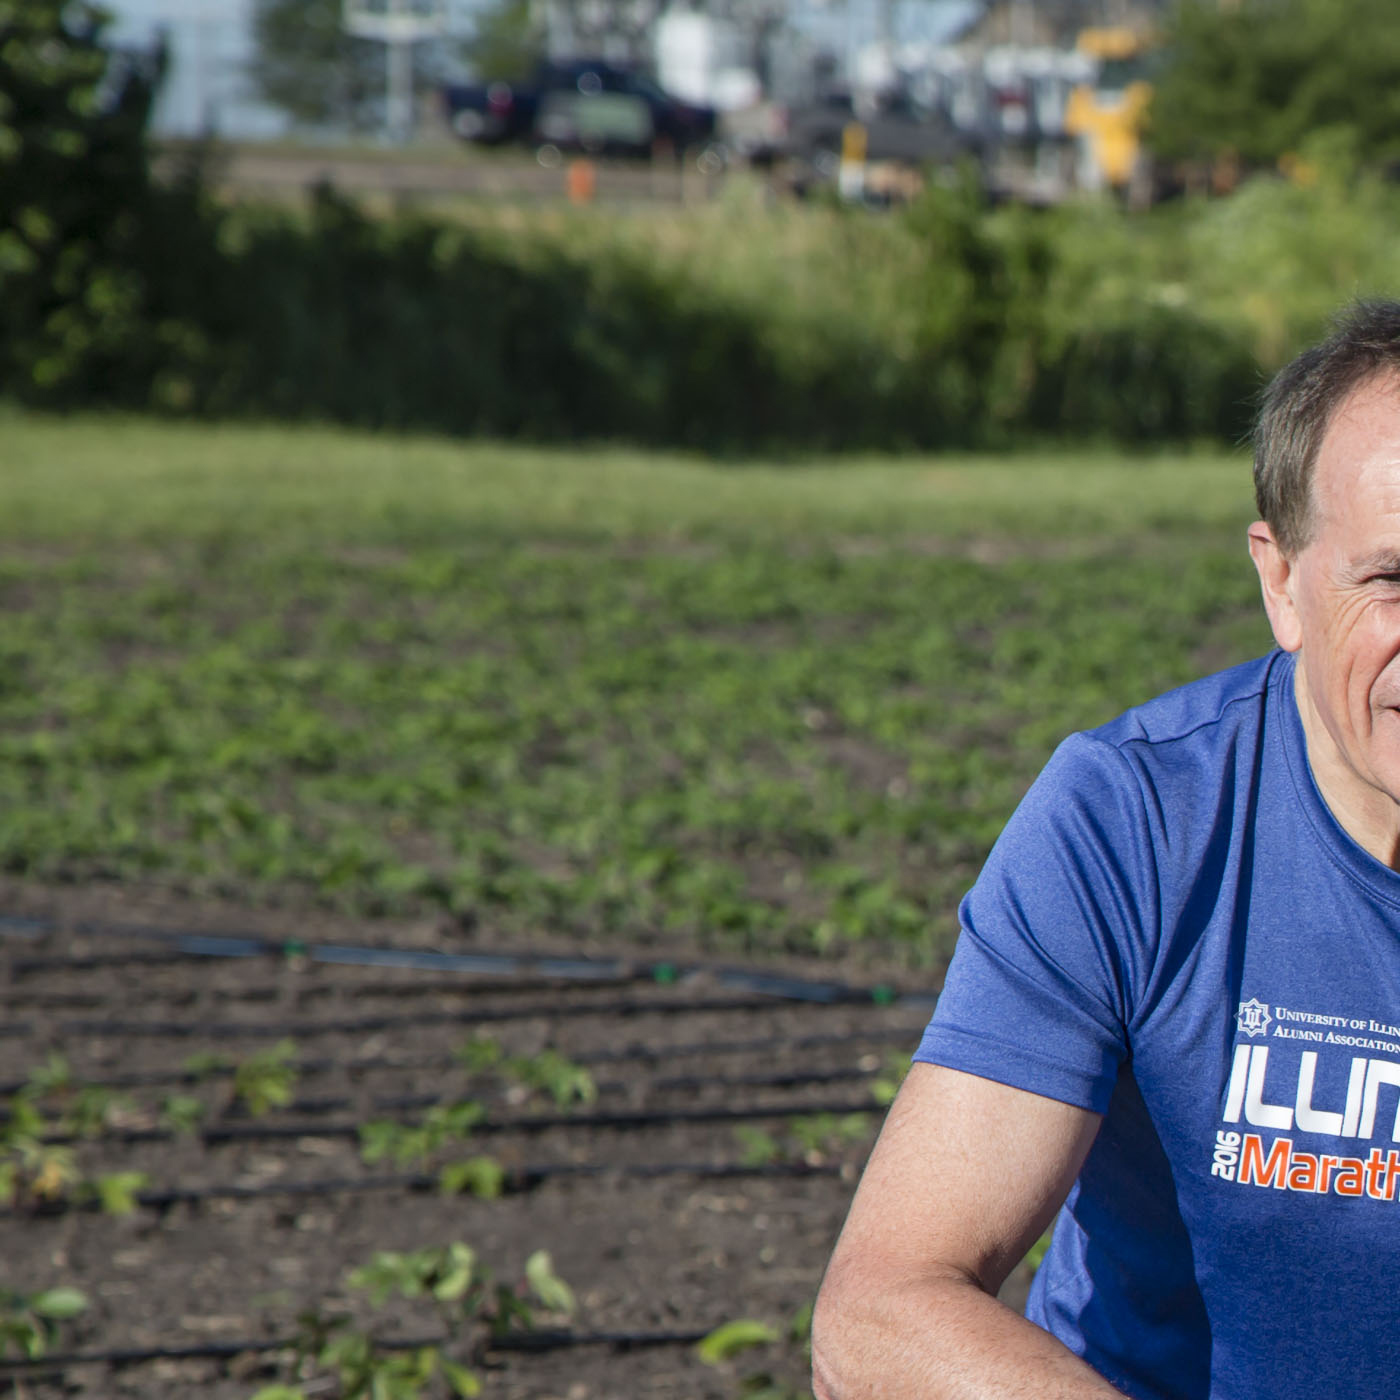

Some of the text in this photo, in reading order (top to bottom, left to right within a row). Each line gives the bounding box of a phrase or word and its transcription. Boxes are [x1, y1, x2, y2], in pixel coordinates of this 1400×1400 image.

[1275, 1007, 1348, 1028] UNIVERSITY
[1273, 1025, 1324, 1042] ALUMNI
[1211, 1130, 1241, 1182] 2016
